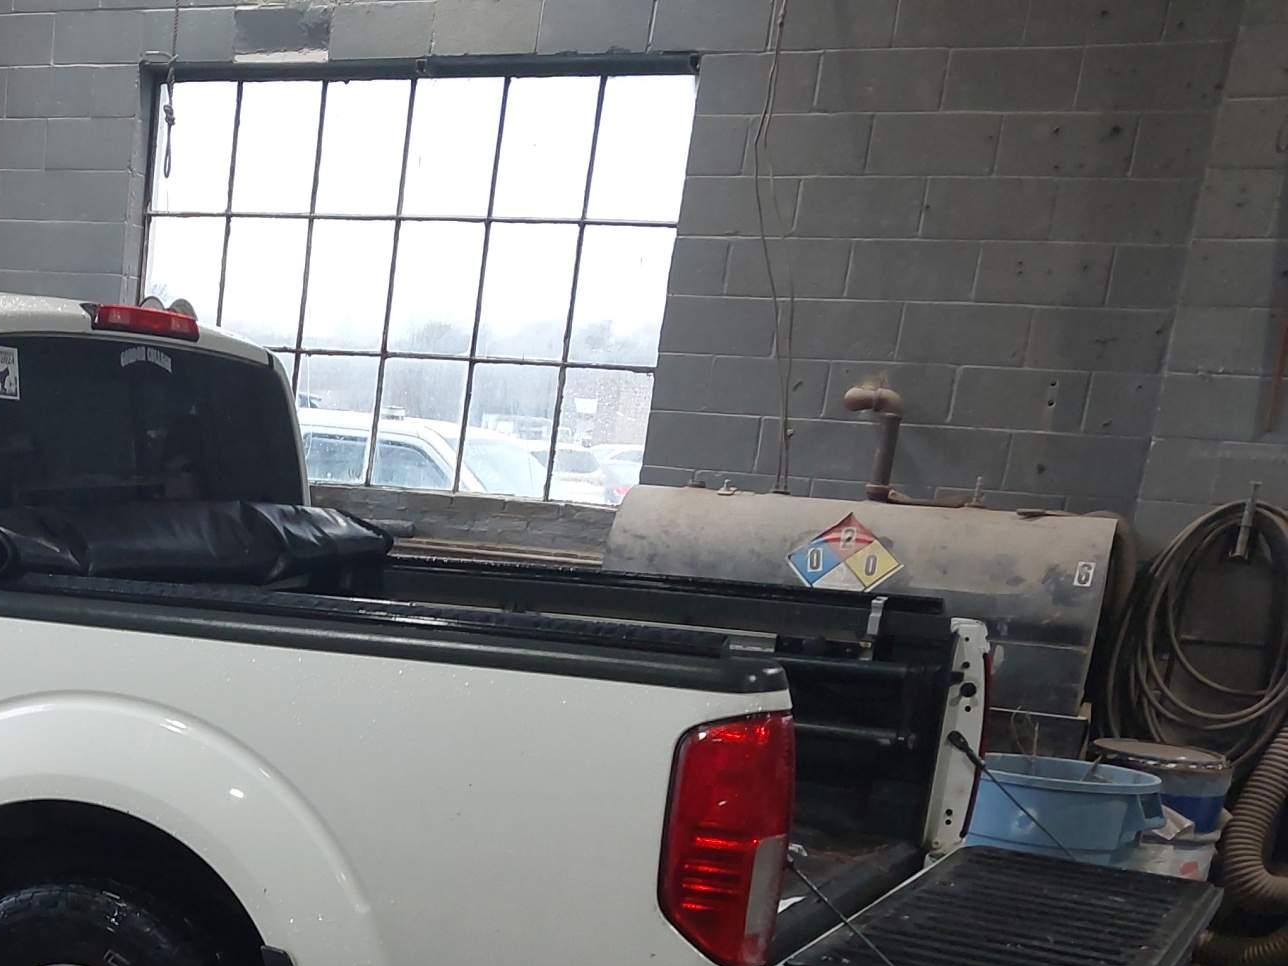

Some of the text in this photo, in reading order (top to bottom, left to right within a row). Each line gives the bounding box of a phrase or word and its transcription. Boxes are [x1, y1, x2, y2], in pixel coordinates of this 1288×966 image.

[841, 528, 856, 549] 2
[808, 549, 822, 571] 0
[864, 554, 879, 577] 0
